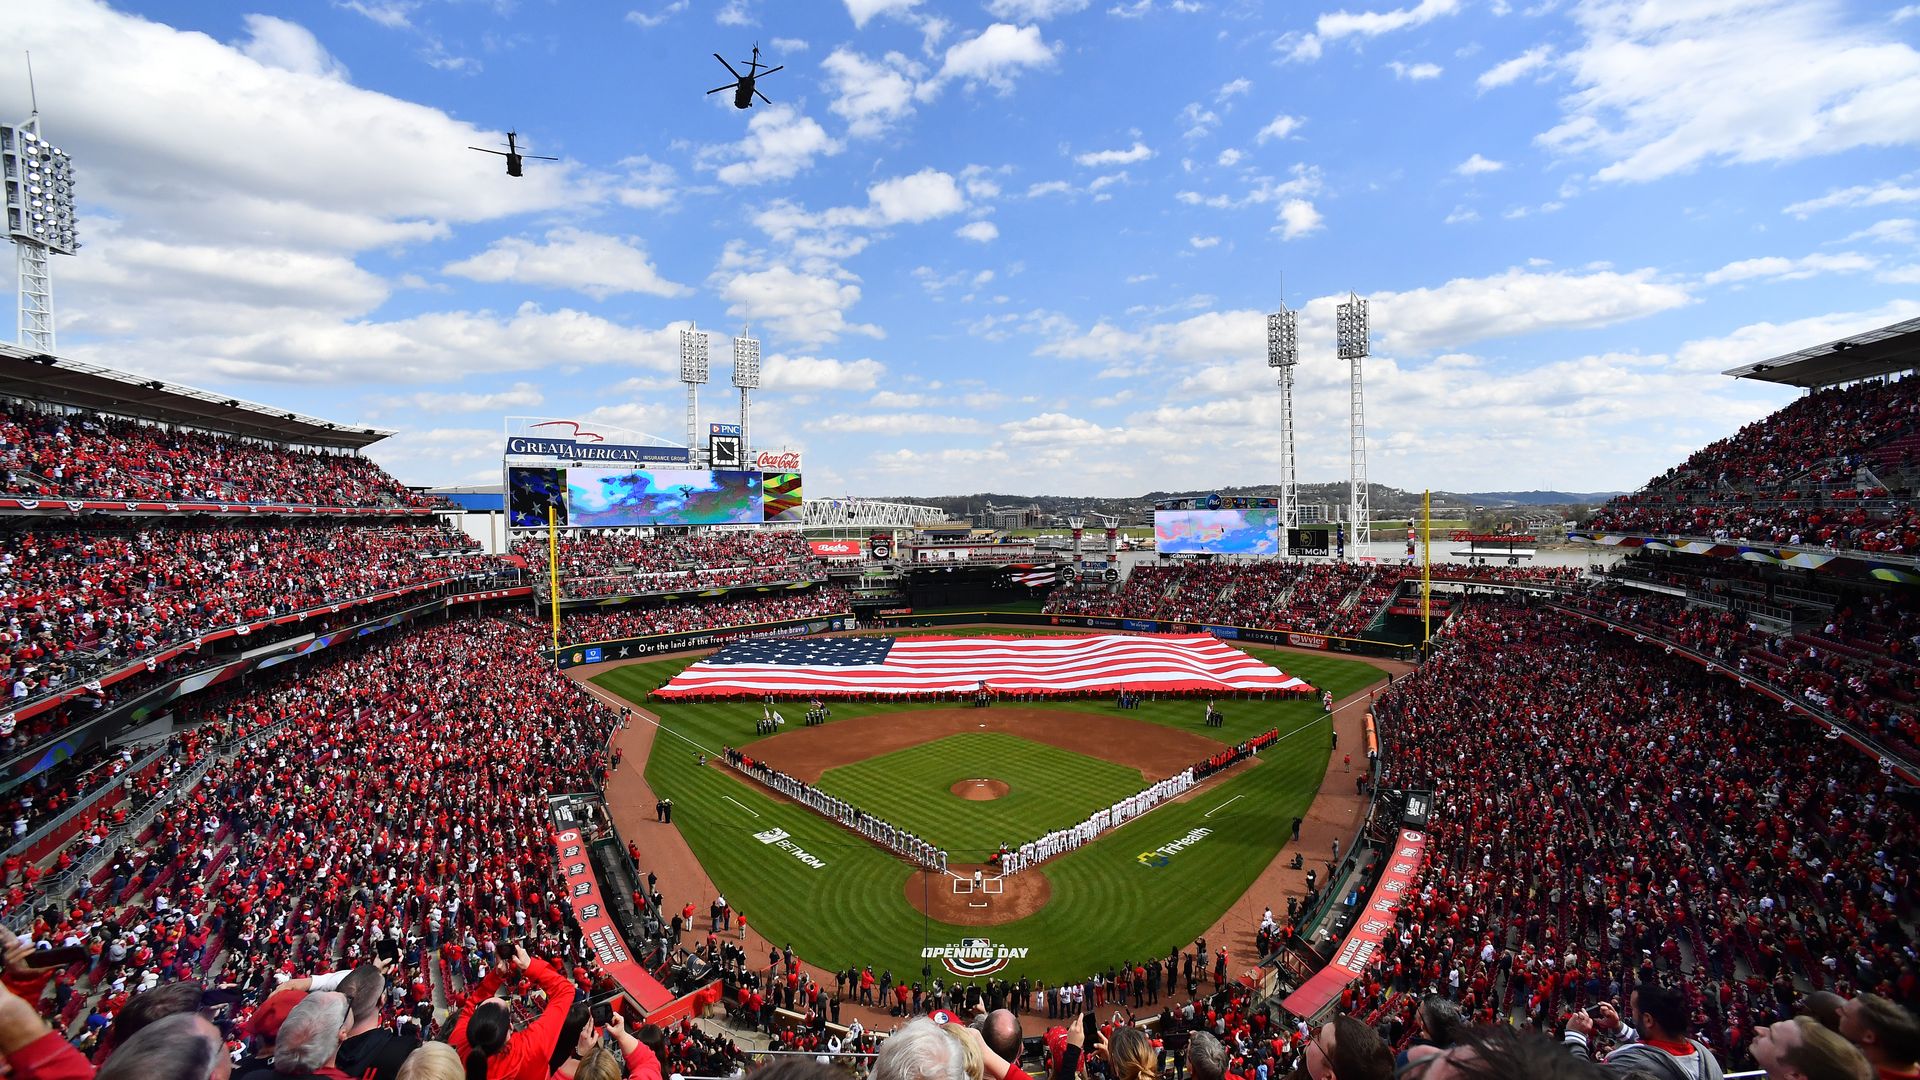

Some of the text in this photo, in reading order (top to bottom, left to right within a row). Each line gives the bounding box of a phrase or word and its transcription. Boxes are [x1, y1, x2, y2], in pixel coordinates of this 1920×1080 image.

[721, 424, 740, 434] PNC
[510, 439, 567, 454] GREAT
[757, 451, 801, 469] Coca-Cola
[1289, 547, 1327, 556] BETMGM
[638, 625, 805, 653] O'er the land of the free and the home of the brave
[1300, 634, 1326, 645] Wyler
[776, 839, 826, 869] BETMGM
[1156, 827, 1214, 855] TriHealth
[589, 931, 616, 965] CHAMPIONS
[600, 925, 628, 963] NATIONAL LEAGUE
[921, 947, 1029, 958] OPENING DAY
[1336, 937, 1361, 967] WORLD SERIES
[1348, 940, 1377, 974] CHAMPIONS
